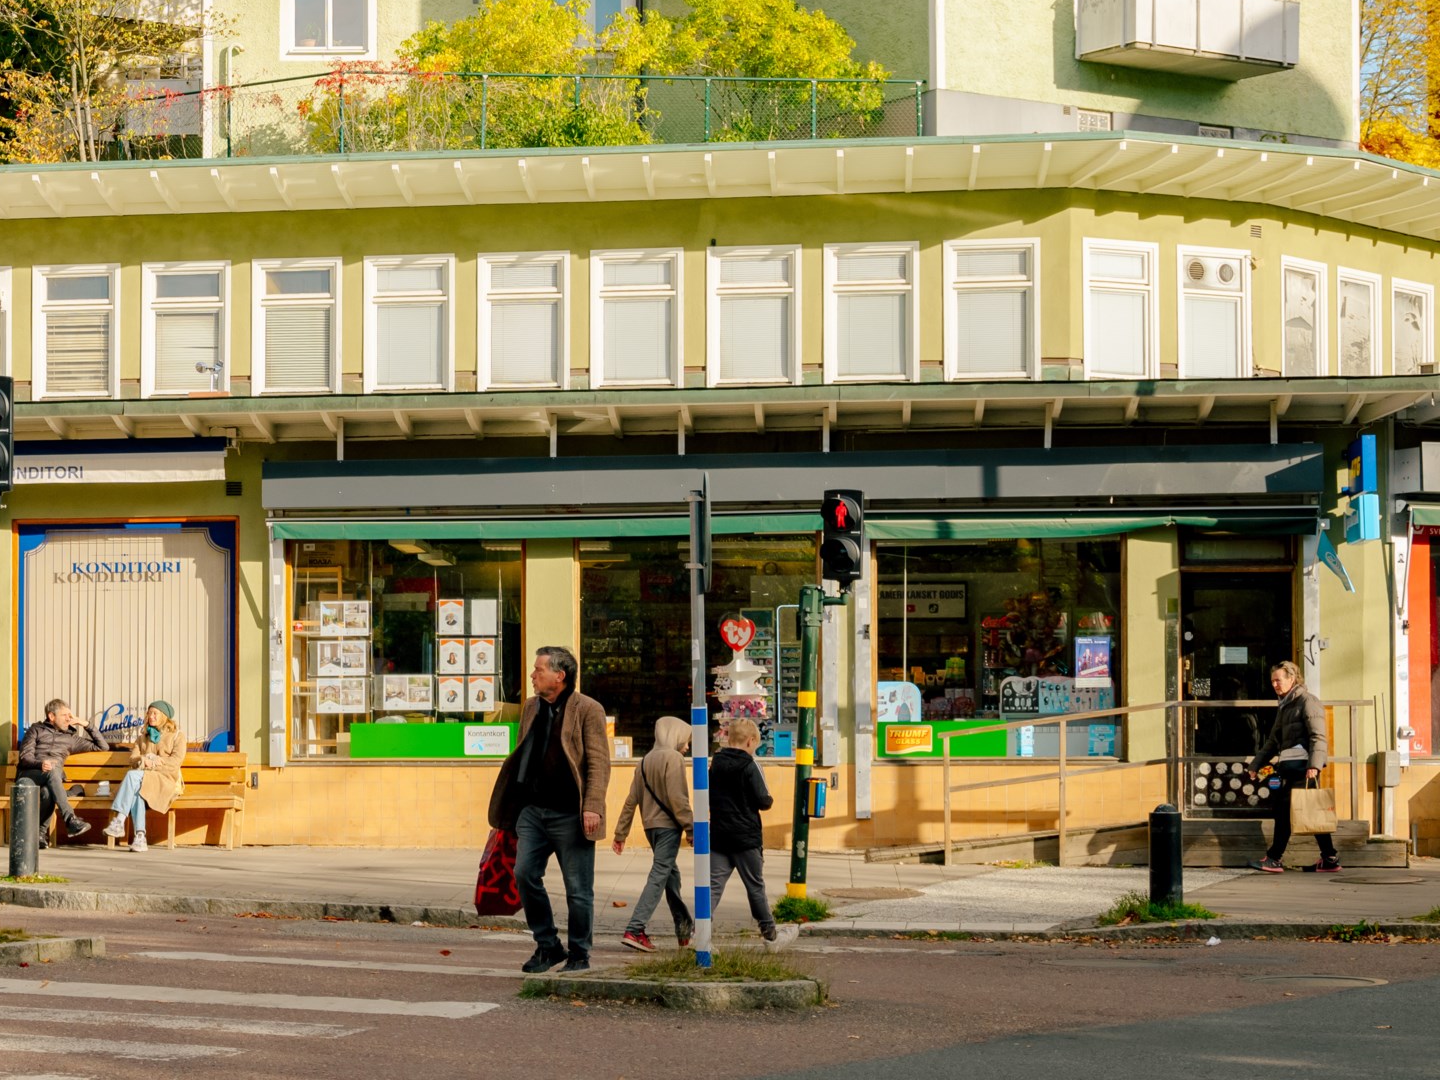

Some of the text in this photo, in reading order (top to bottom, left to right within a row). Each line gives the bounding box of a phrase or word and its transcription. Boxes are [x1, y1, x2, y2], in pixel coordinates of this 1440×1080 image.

[12, 466, 83, 480] NDITORI
[72, 561, 182, 574] KONDITORI
[723, 621, 752, 647] ty
[98, 703, 146, 733] Lundber
[889, 729, 928, 738] TRIUMF
